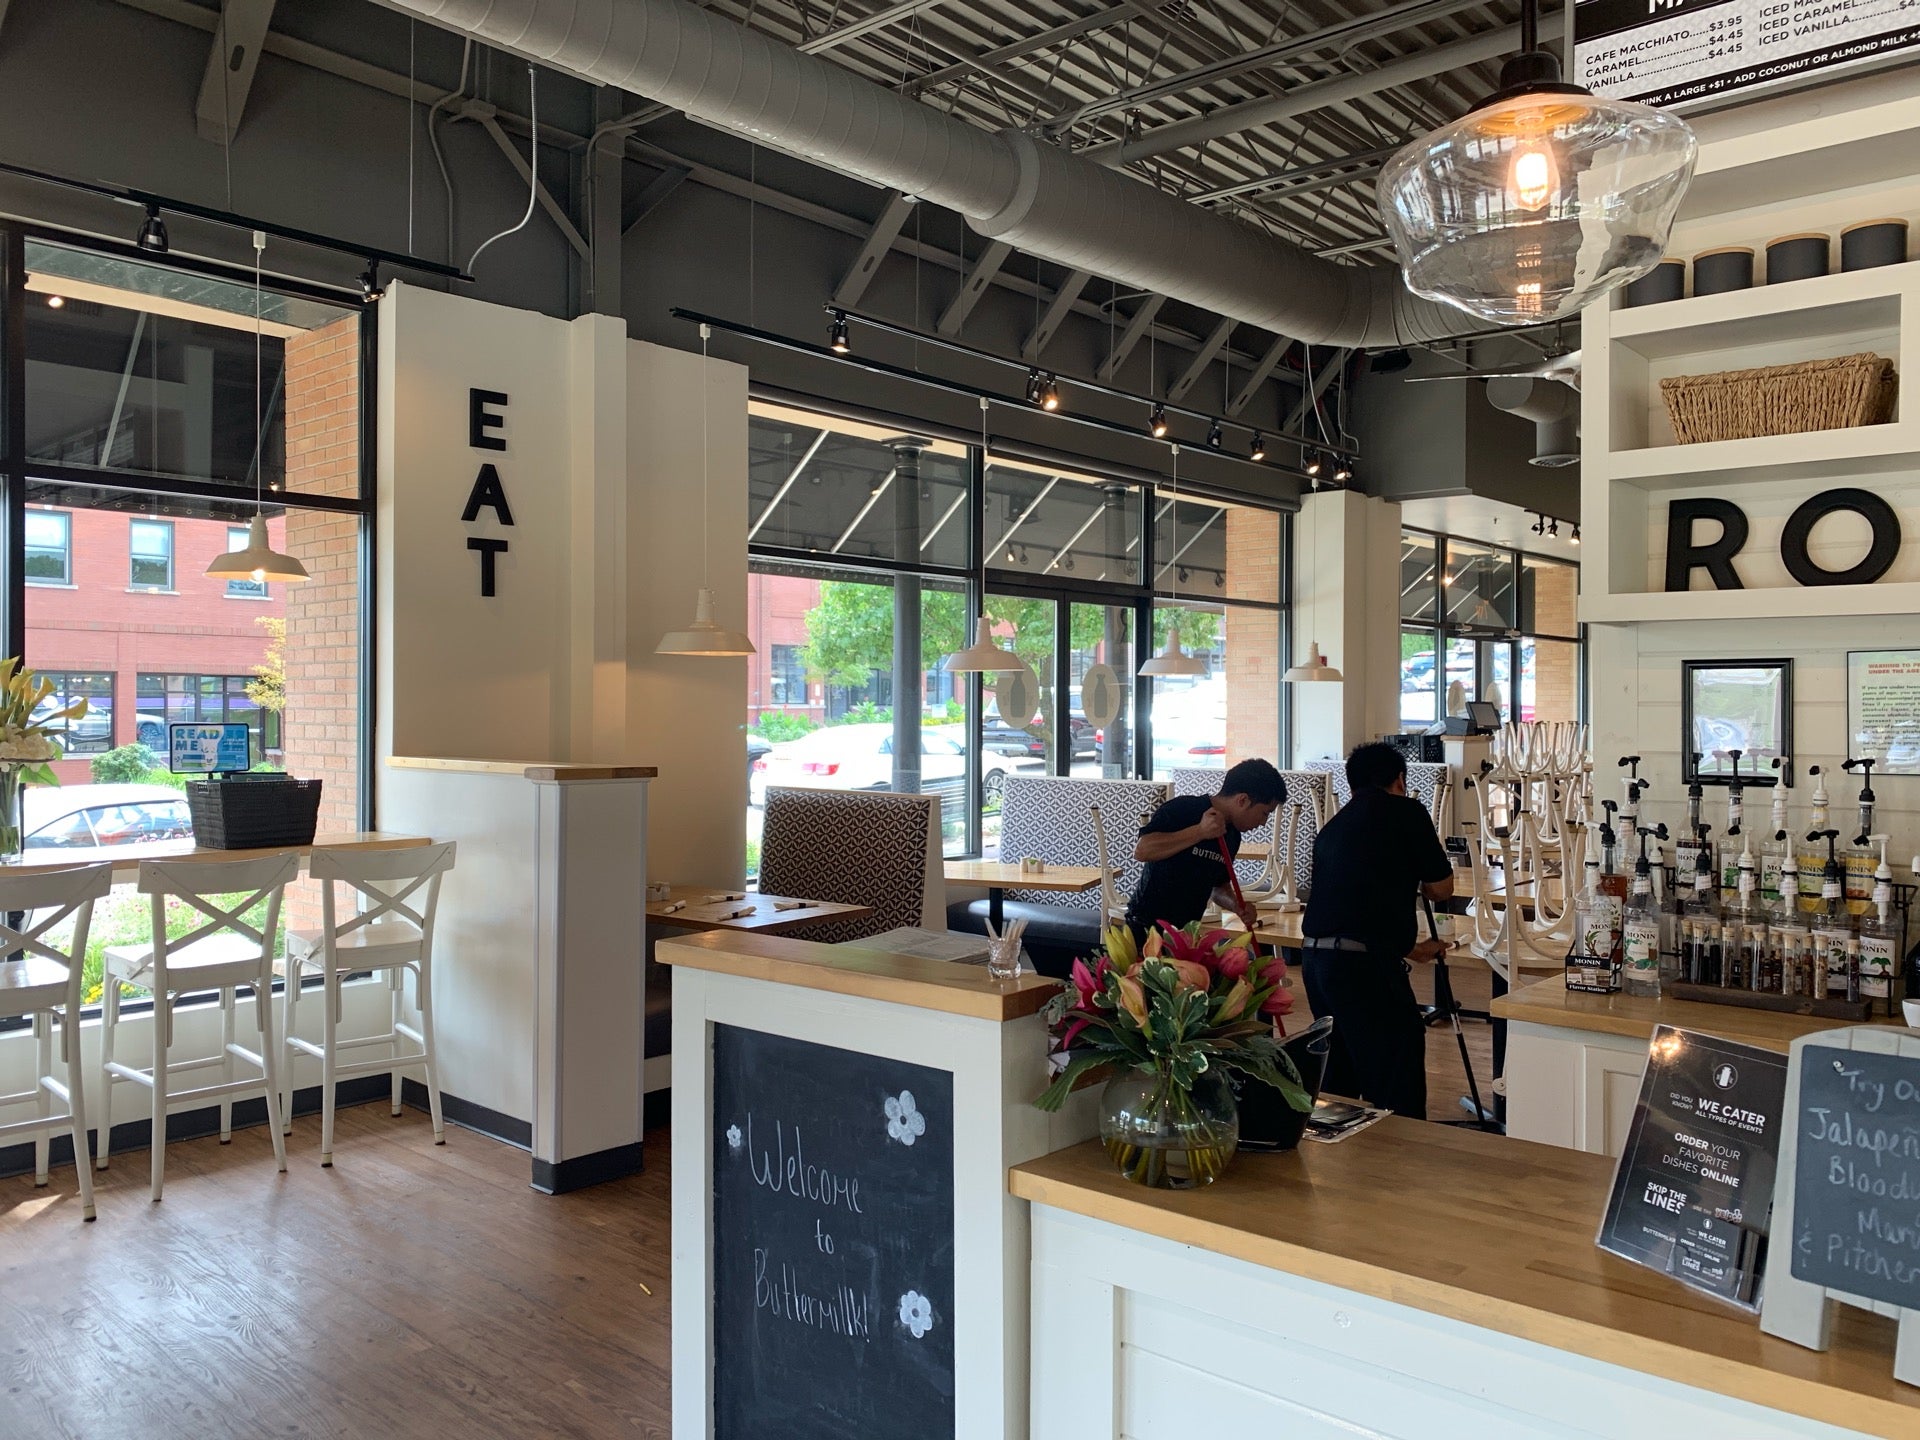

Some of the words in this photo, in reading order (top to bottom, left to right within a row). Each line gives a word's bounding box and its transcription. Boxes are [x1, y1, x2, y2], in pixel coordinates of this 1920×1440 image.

[1759, 3, 1789, 18] ICED
[1759, 17, 1789, 32] ICED
[1794, 0, 1858, 23] CARAMEL
[1586, 50, 1616, 65] CAFE
[1620, 30, 1690, 57] MACCHIATO
[1709, 15, 1742, 32] $3.95
[1758, 31, 1789, 46] ICED
[1794, 15, 1850, 36] VANILLA
[1586, 57, 1642, 78] CARAMEL
[1708, 29, 1743, 46] $4.45
[1586, 71, 1634, 91] VANILLA
[1708, 43, 1743, 60] $4.45
[1664, 93, 1672, 102] A
[1674, 84, 1707, 99] LARGE
[1708, 79, 1724, 90] +$1
[1734, 71, 1756, 84] ADD
[1758, 58, 1810, 78] COCONUT
[1812, 54, 1829, 65] OR
[1830, 41, 1878, 60] ALMOND
[1881, 32, 1908, 48] MILK
[460, 386, 515, 597] EAT
[1664, 486, 1902, 592] RO
[175, 728, 220, 740] READ
[175, 740, 199, 751] ME
[1192, 846, 1226, 865] BUTTERM
[1799, 864, 1825, 873] ONIN
[1846, 865, 1872, 873] ONIN
[1626, 931, 1656, 940] MONIN
[1574, 957, 1601, 966] MONIN
[1861, 945, 1888, 954] ONIN
[1569, 983, 1586, 991] Flavor
[1587, 985, 1607, 993] Station
[1670, 1091, 1680, 1101] DID
[1681, 1094, 1694, 1104] YOU
[1841, 1069, 1885, 1112] Try
[1671, 1100, 1693, 1111] KNOW?
[1698, 1097, 1720, 1114] WE
[1722, 1105, 1767, 1128] CATER
[1694, 1110, 1707, 1119] ALL
[1708, 1113, 1727, 1124] TYPES
[1727, 1118, 1738, 1127] OF
[1738, 1122, 1763, 1135] EVENTS
[1674, 1132, 1709, 1152] ORDER
[1711, 1143, 1741, 1161] YOUR
[1678, 1146, 1730, 1170] FAVORITE
[747, 1111, 863, 1214] Welcome
[1662, 1154, 1699, 1174] DISHES
[1700, 1167, 1740, 1188] ONLINE
[1643, 1190, 1686, 1215] LINES
[1646, 1181, 1668, 1195] SKIP
[1669, 1189, 1687, 1203] THE
[813, 1218, 835, 1255] to
[1708, 1234, 1727, 1247] CATER
